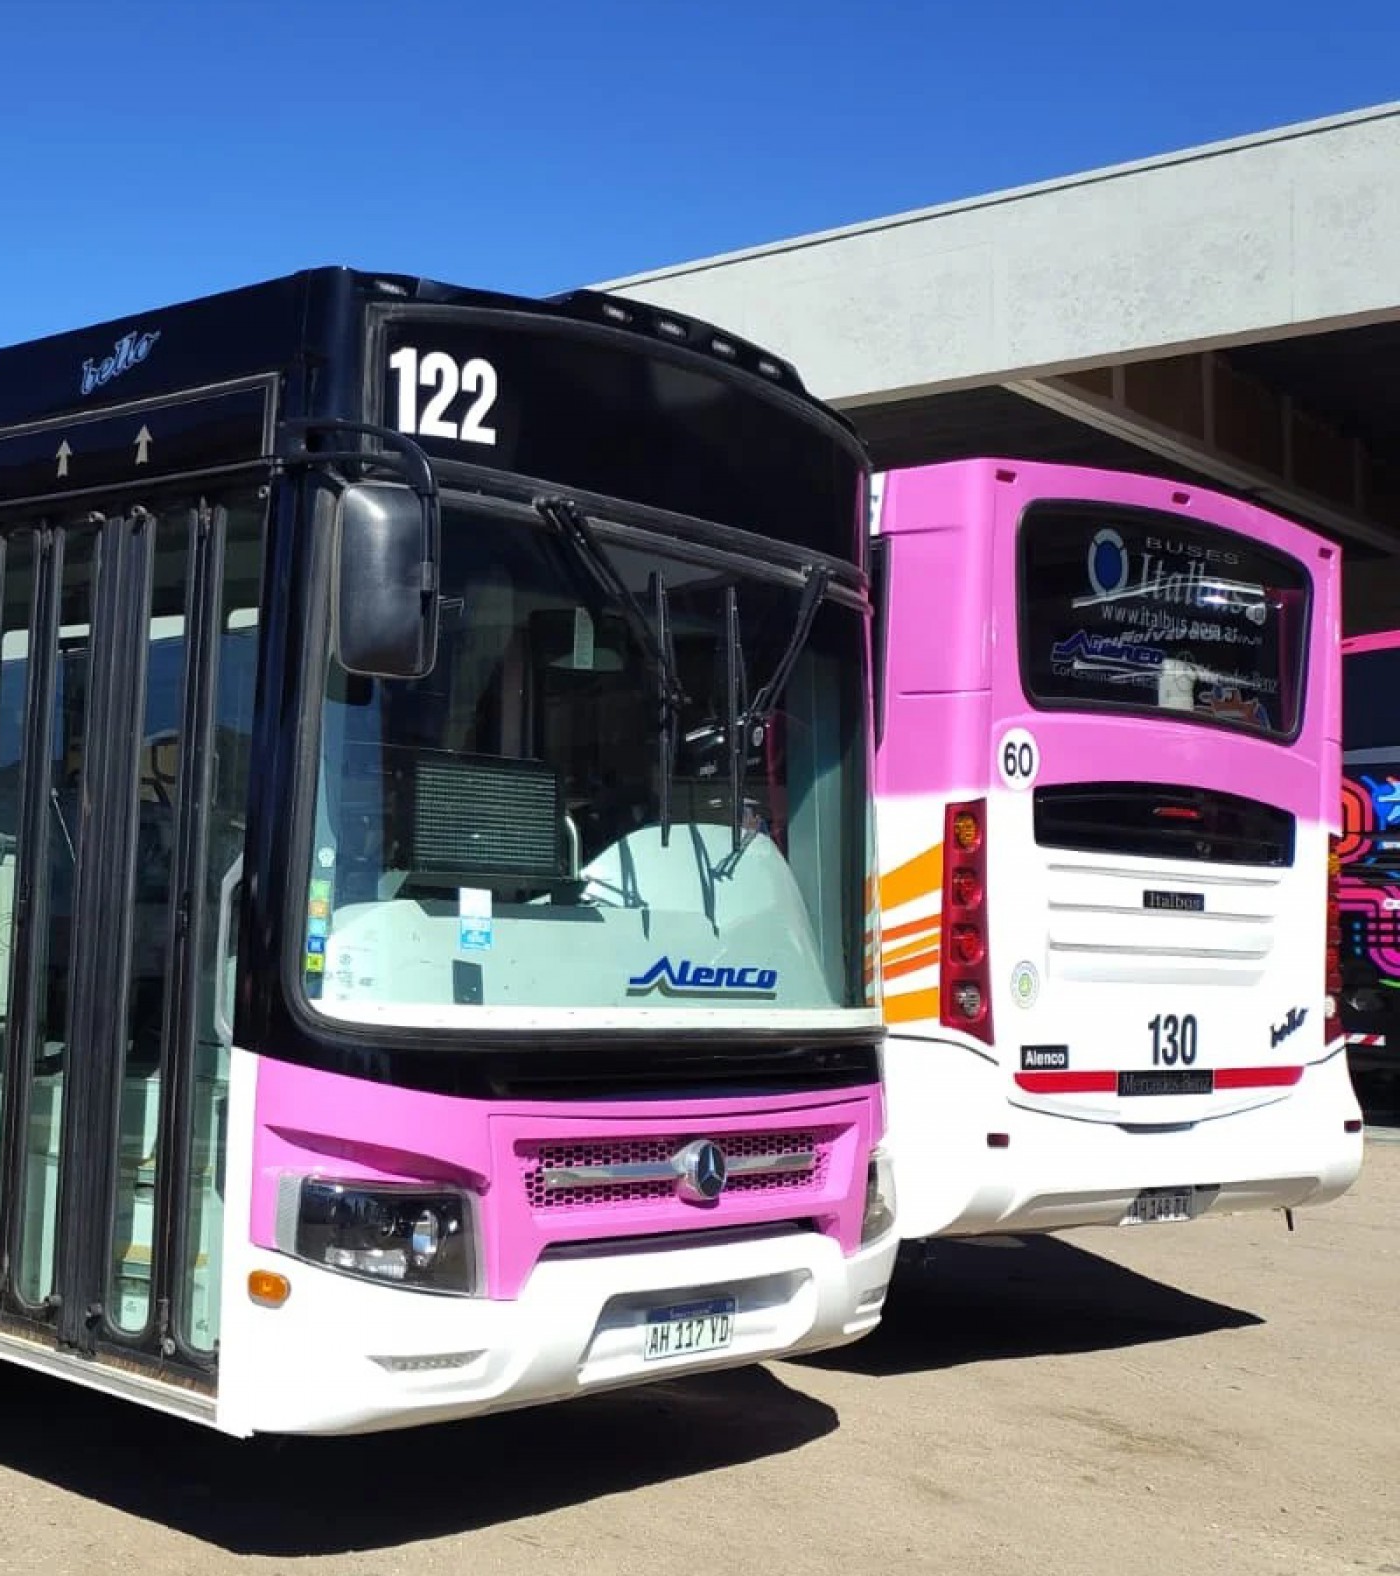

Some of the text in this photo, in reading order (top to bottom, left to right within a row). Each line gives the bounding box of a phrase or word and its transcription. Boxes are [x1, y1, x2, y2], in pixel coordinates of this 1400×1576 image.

[389, 346, 498, 446] 122
[1145, 537, 1240, 565] BUSES
[1004, 741, 1033, 777] 60
[629, 955, 778, 989] Alenco
[1025, 1049, 1065, 1067] Alenco
[1147, 1013, 1198, 1067] 130
[648, 1325, 670, 1356] AH
[674, 1319, 705, 1352] 117
